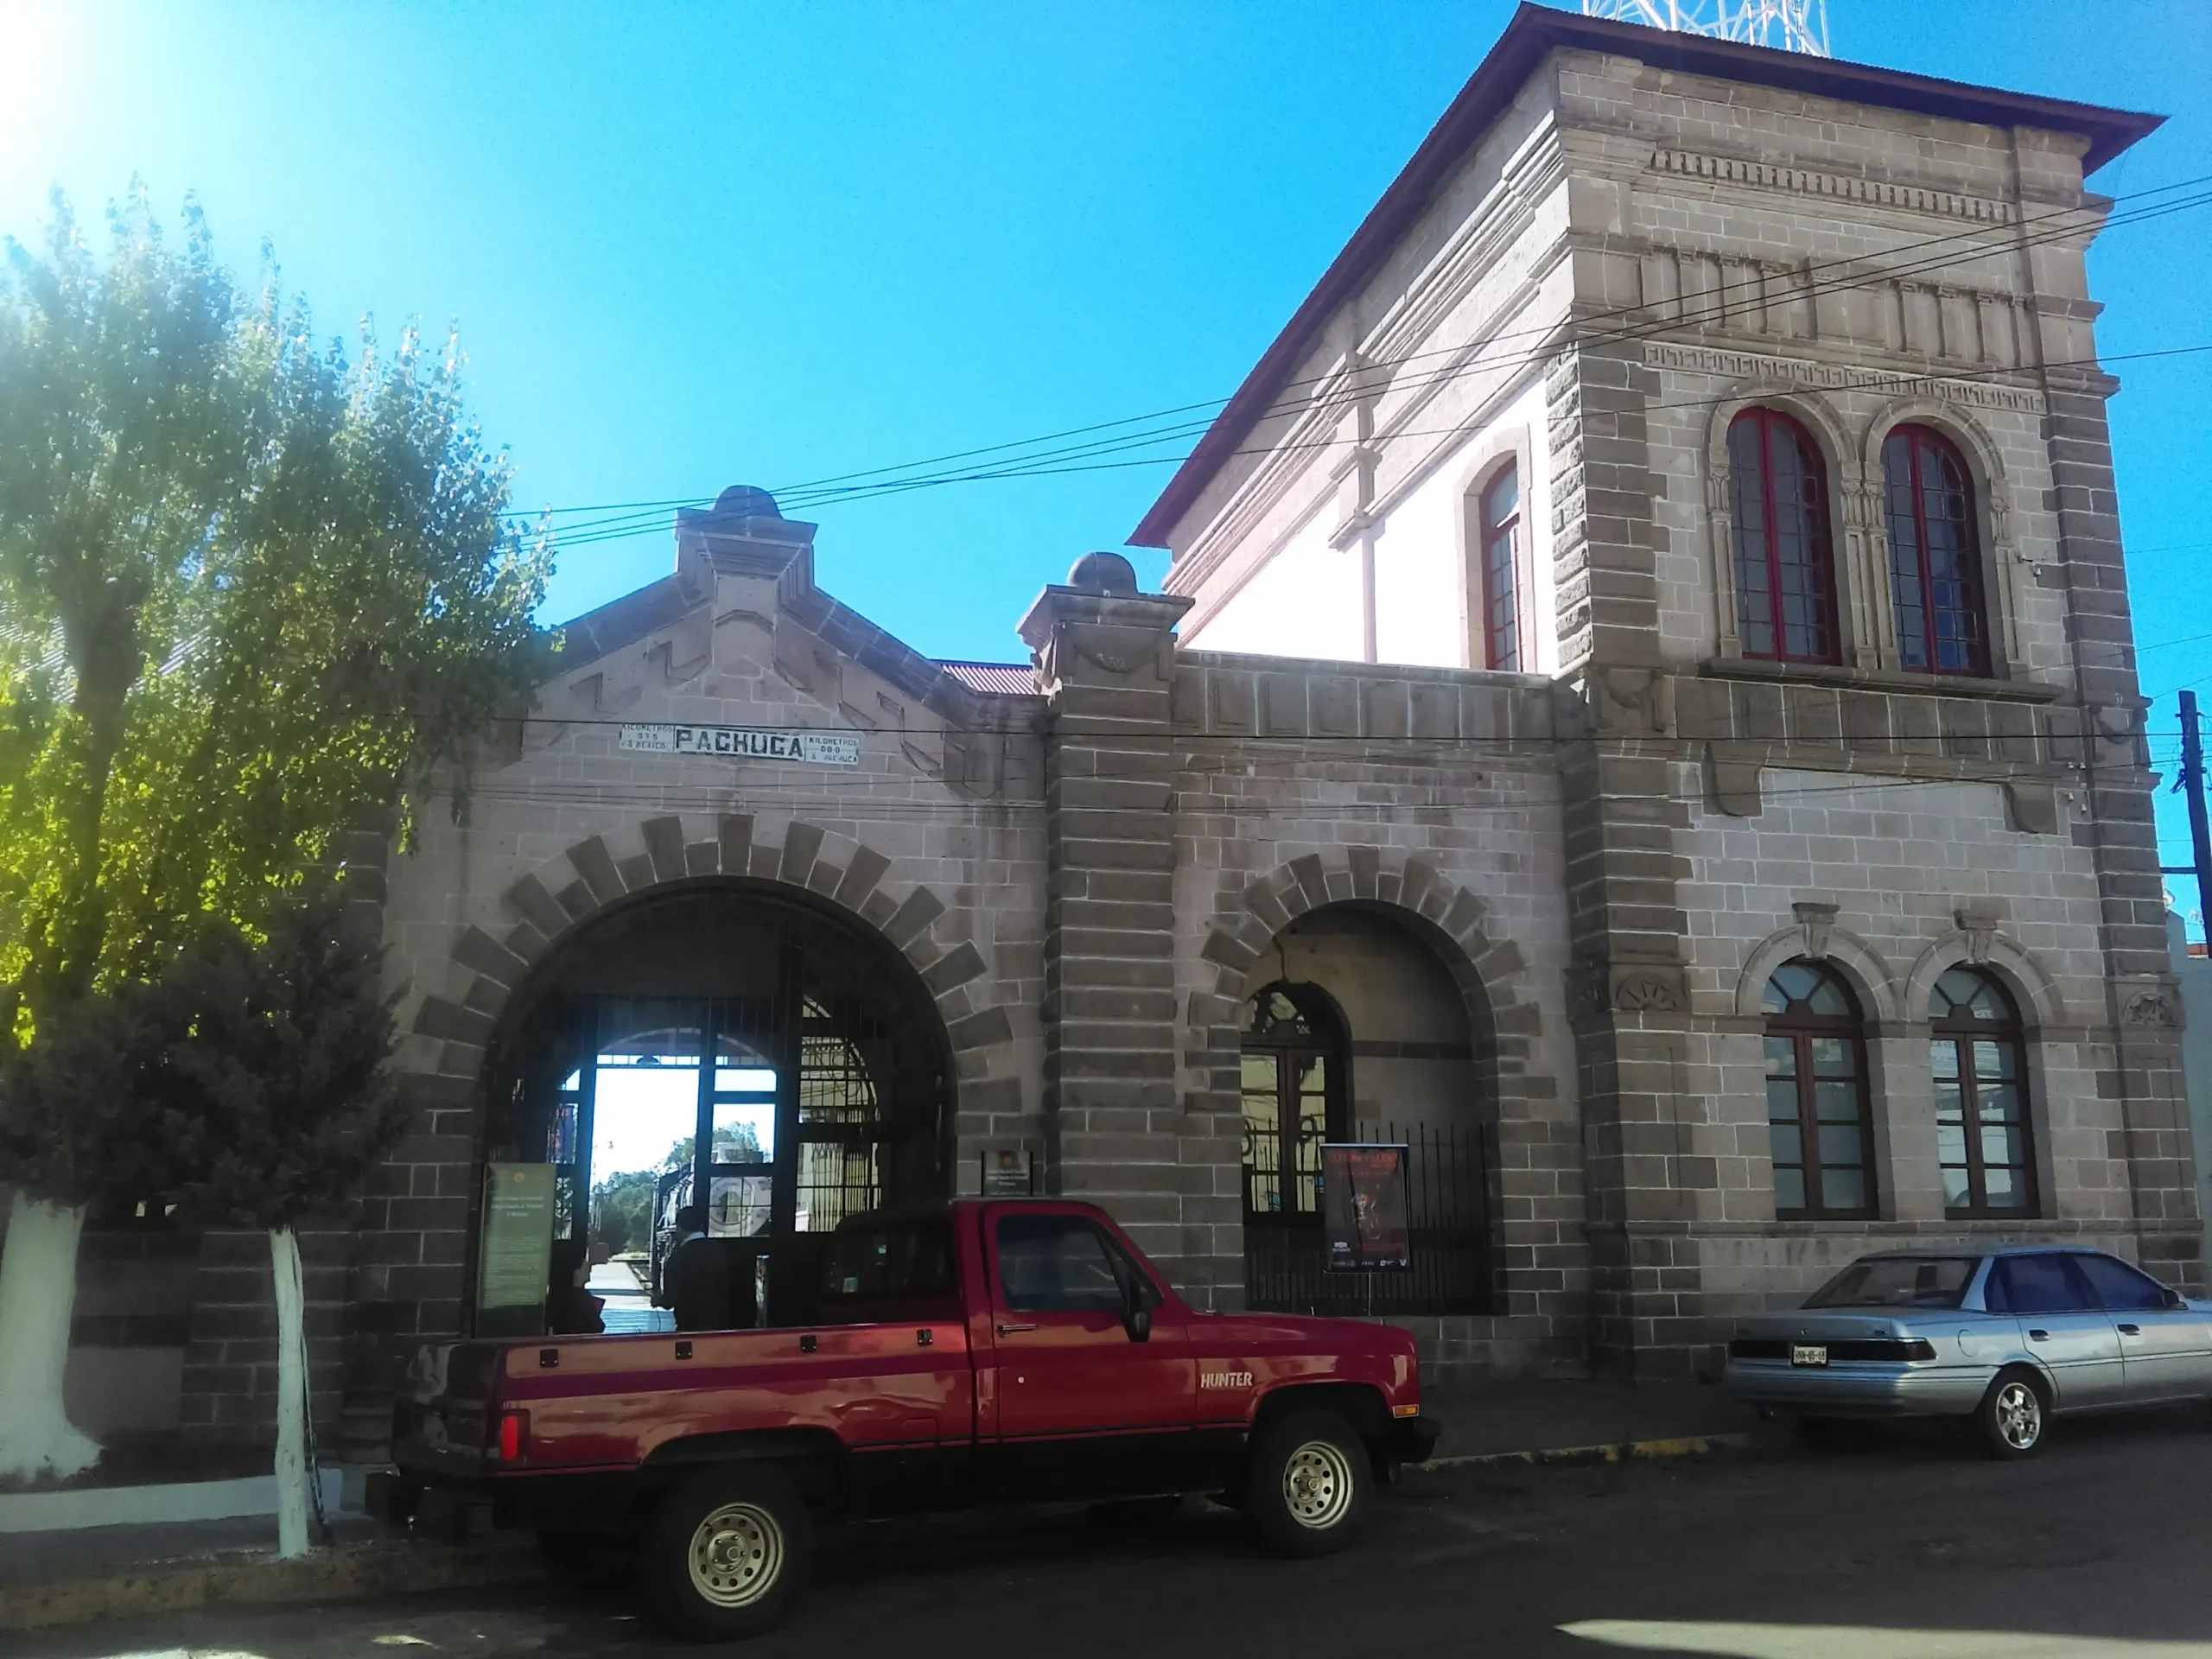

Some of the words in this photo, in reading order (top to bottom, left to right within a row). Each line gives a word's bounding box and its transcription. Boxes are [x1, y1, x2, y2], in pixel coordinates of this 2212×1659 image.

[676, 728, 804, 758] PACHUCA
[809, 737, 858, 747] KILOMETROS
[823, 754, 857, 763] PACHUCA
[1200, 1372, 1253, 1389] HUNTER
